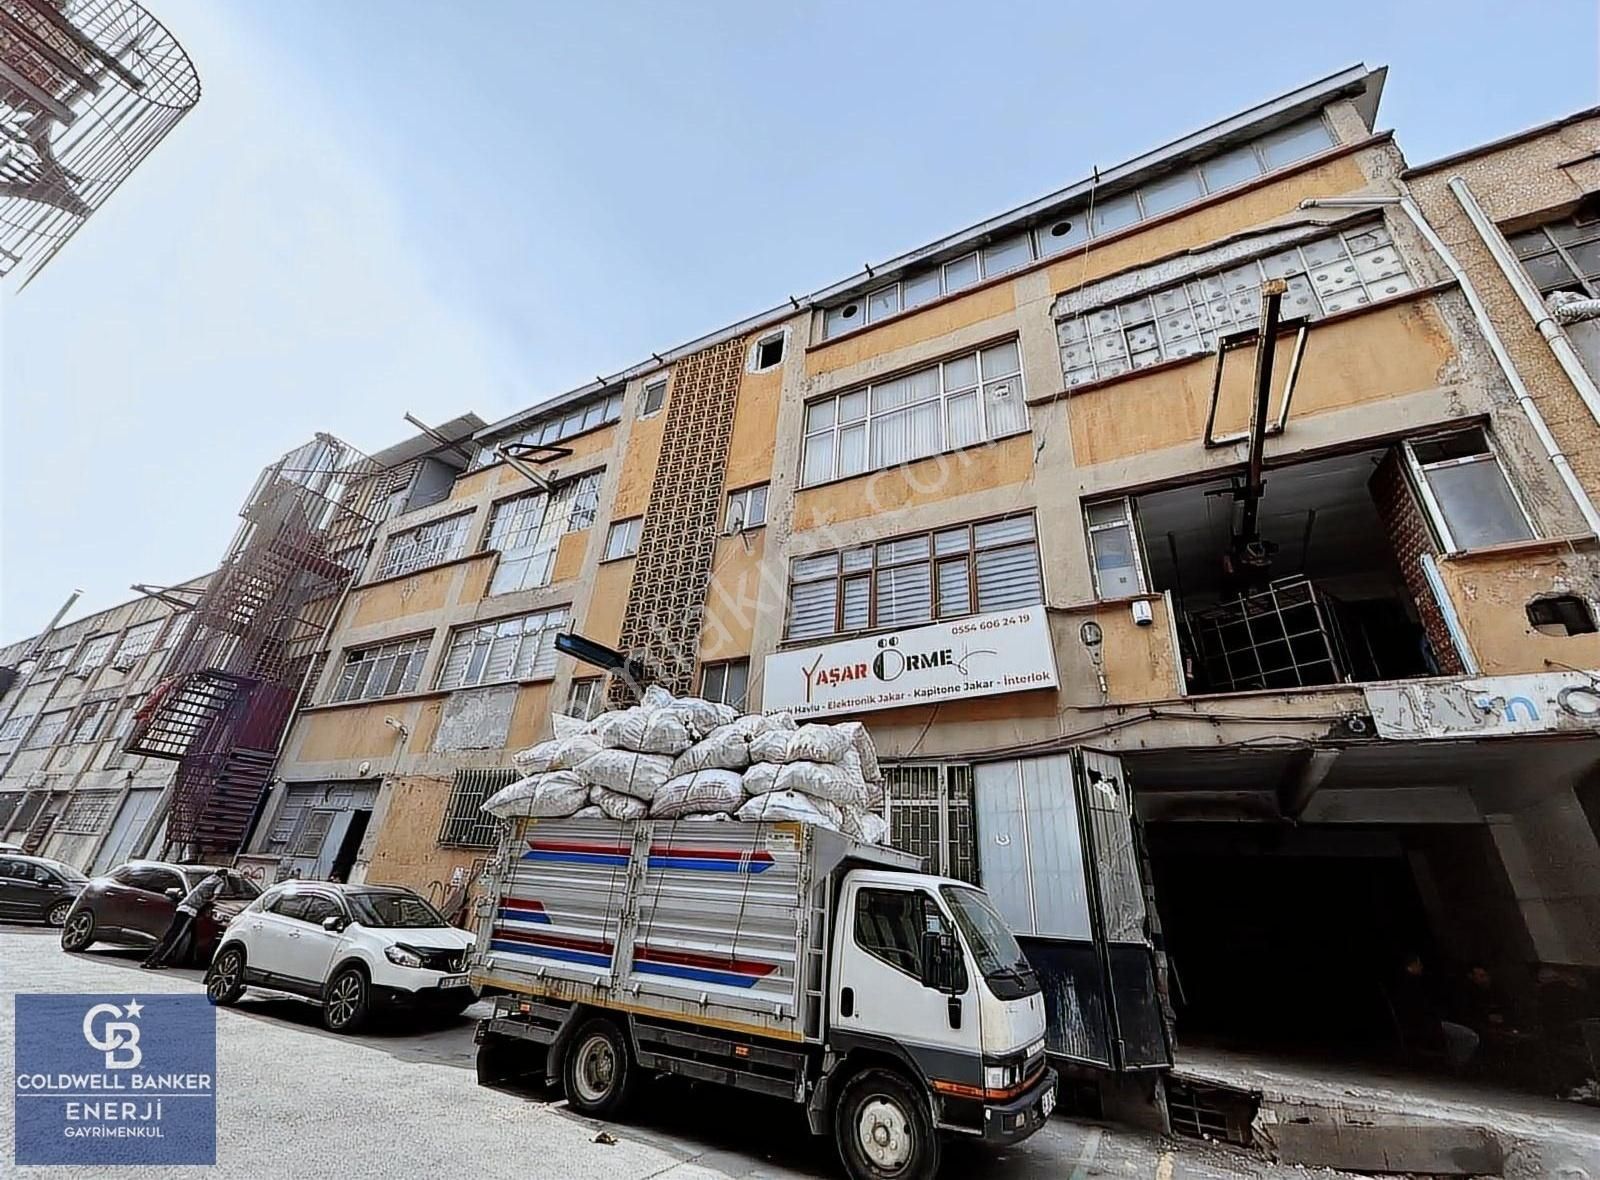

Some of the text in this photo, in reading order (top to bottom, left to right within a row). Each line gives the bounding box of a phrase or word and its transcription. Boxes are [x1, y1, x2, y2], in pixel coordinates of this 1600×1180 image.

[951, 624, 977, 635] 0554
[1003, 616, 1016, 626] 24
[1018, 614, 1030, 623] 19
[802, 636, 954, 702] YAŞAR ÖRME
[827, 694, 876, 710] Elektronik
[878, 691, 905, 703] Jakar
[913, 683, 961, 699] Kapitone
[963, 679, 994, 692] Jakar
